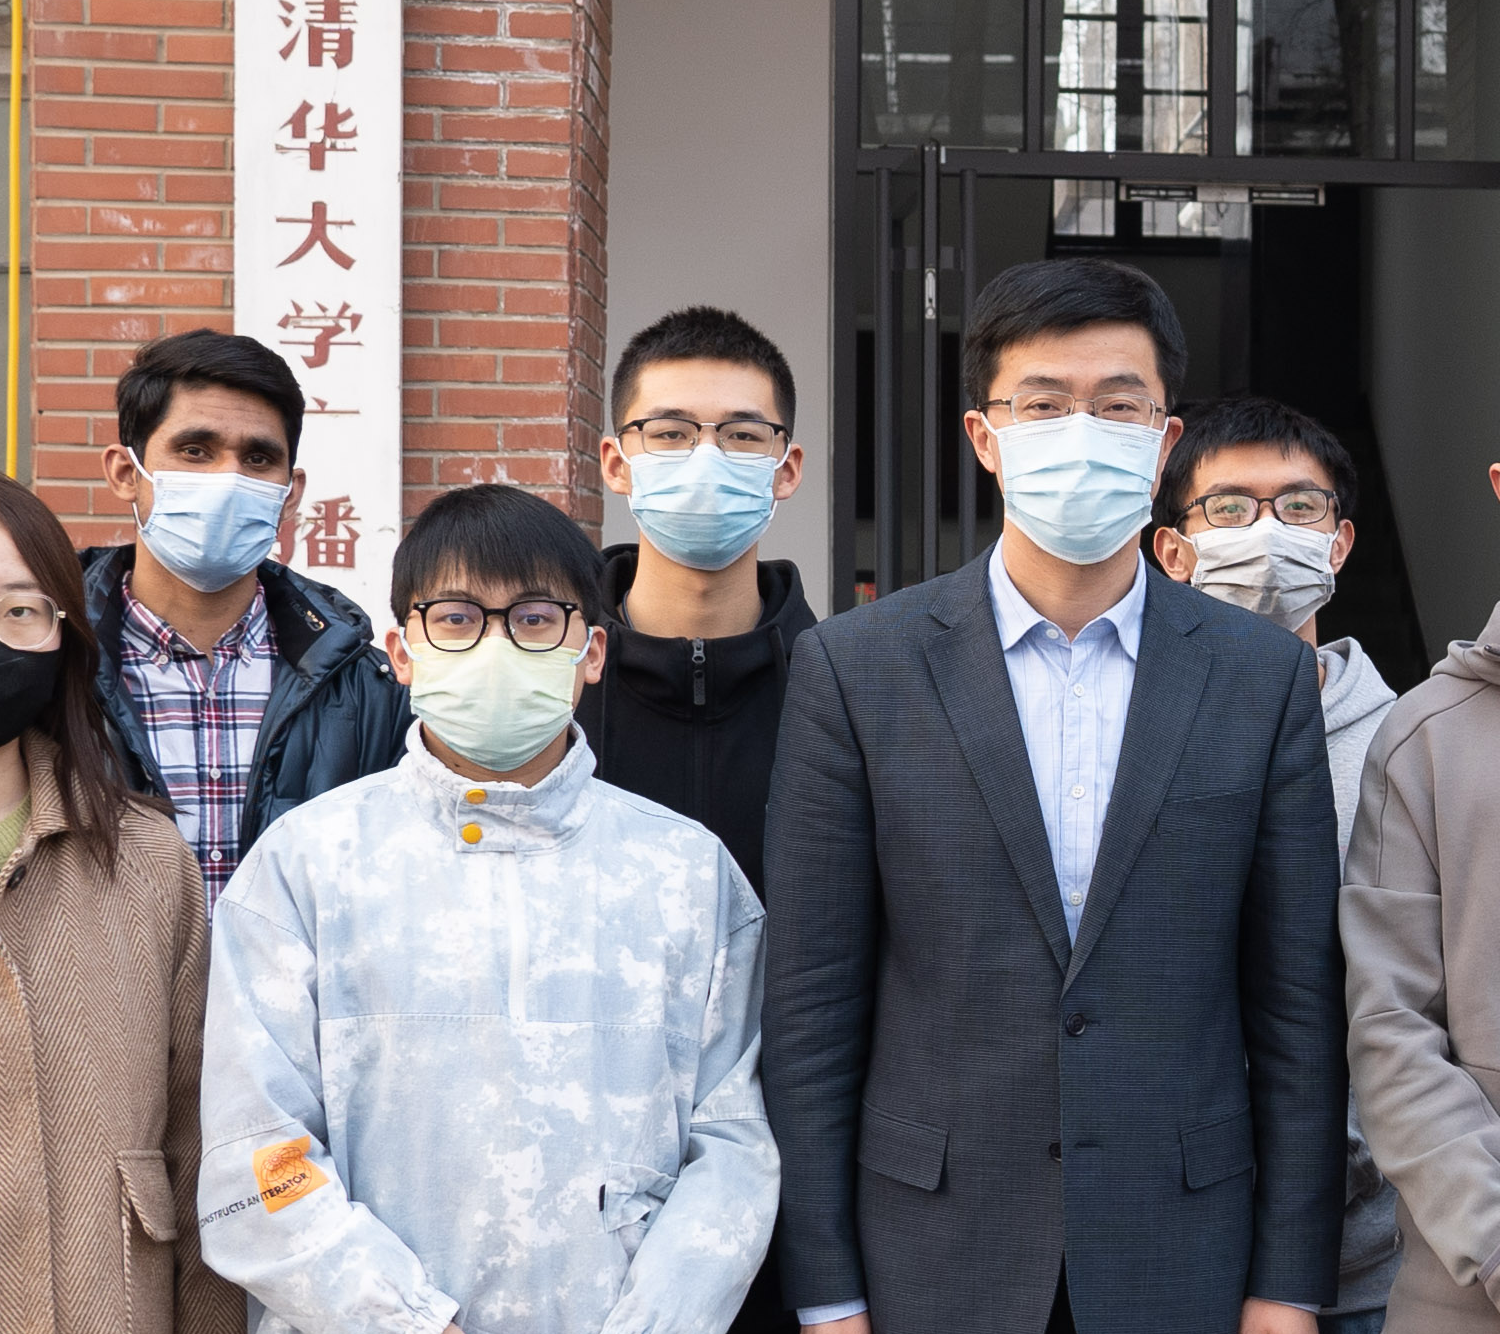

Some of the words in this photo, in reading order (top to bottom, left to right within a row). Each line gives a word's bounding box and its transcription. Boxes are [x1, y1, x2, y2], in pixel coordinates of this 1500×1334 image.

[198, 1199, 246, 1229] ONSTRUCTS
[247, 1194, 260, 1207] AN
[260, 1172, 309, 1203] ITERATOR
